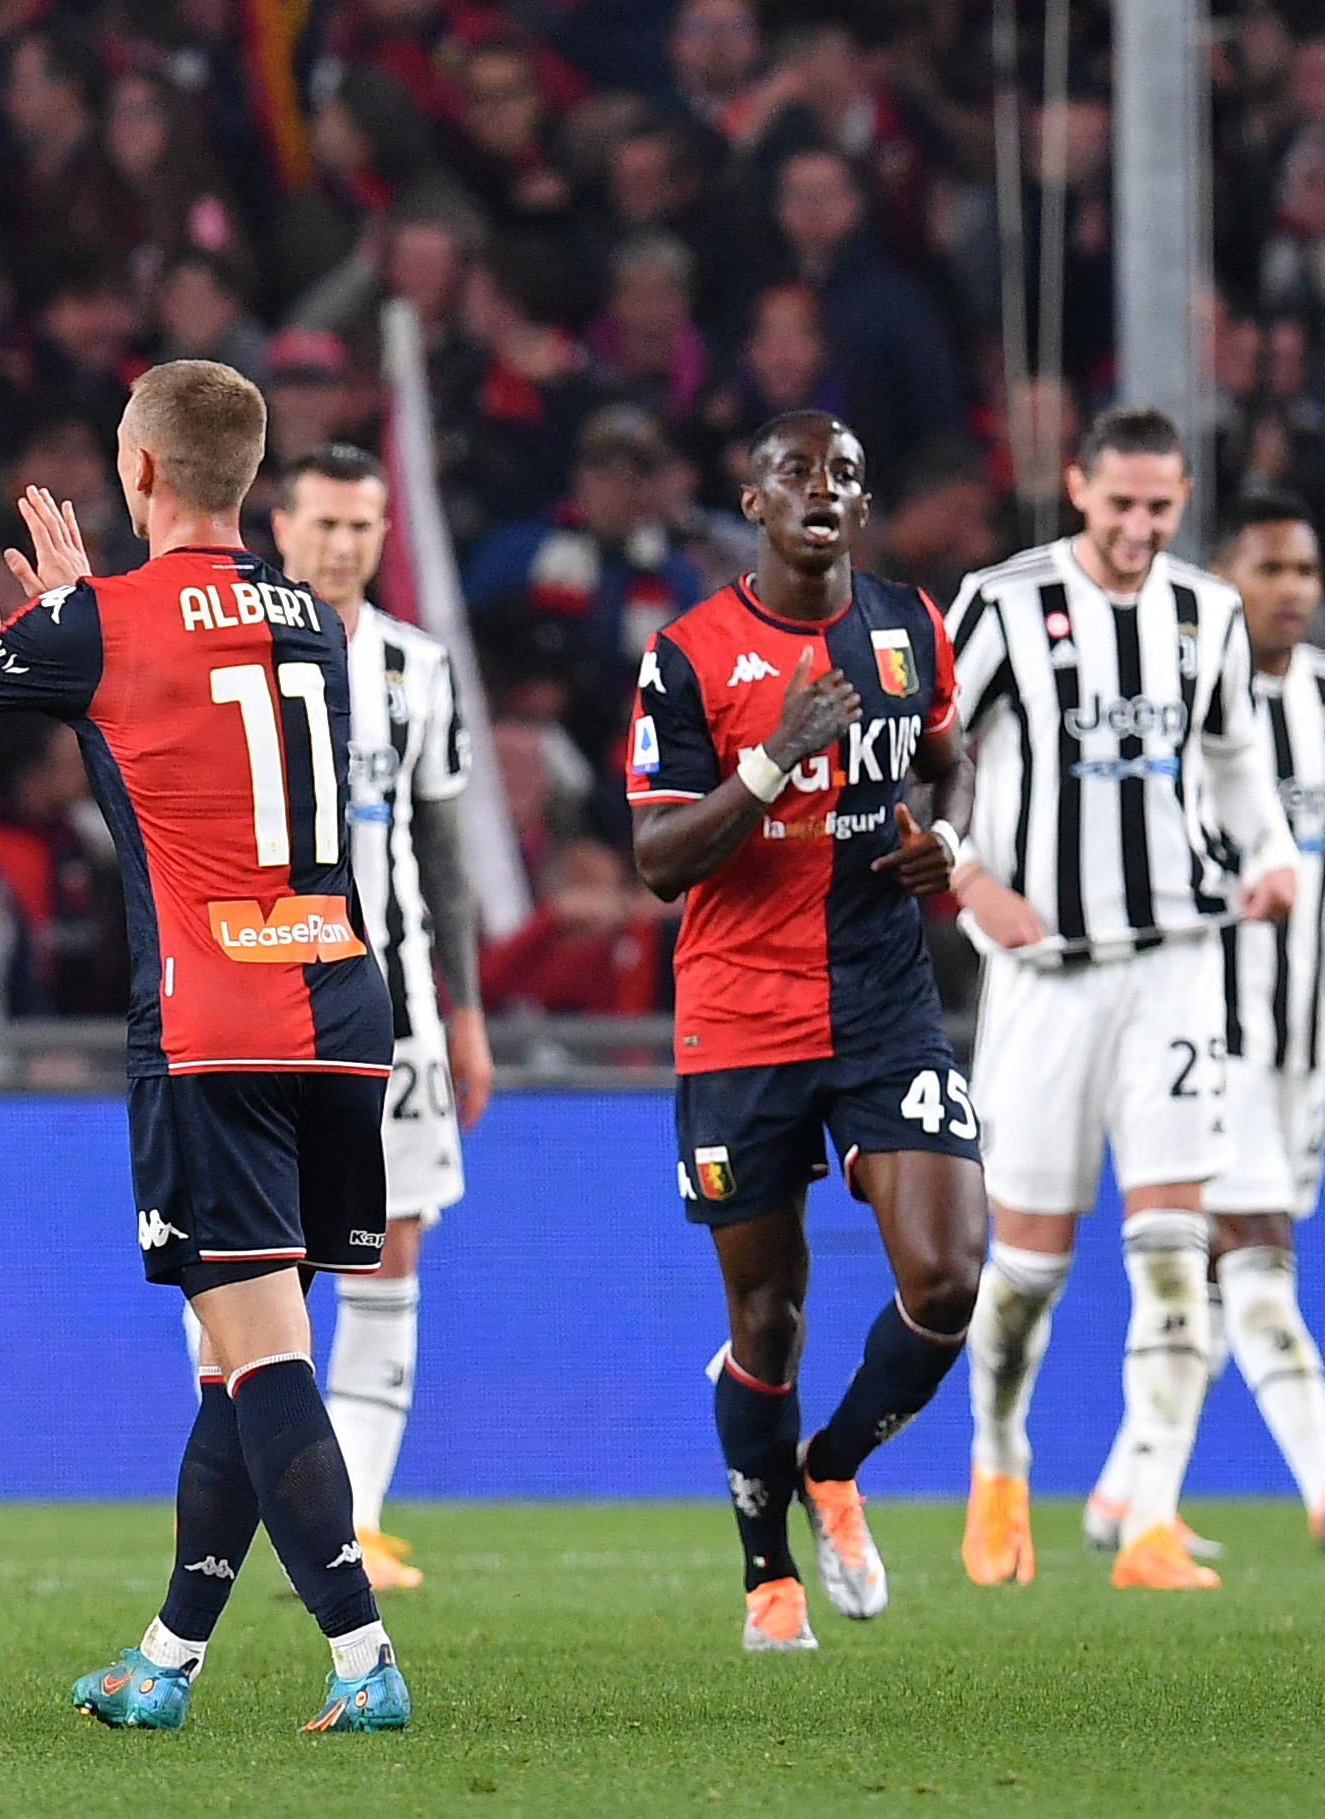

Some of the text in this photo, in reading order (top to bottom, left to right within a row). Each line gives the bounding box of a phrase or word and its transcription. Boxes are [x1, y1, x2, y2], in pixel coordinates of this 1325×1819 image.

[179, 582, 322, 632] ALBERT
[210, 662, 339, 867] 11
[220, 914, 350, 947] LeasePlan
[900, 1068, 978, 1140] 45
